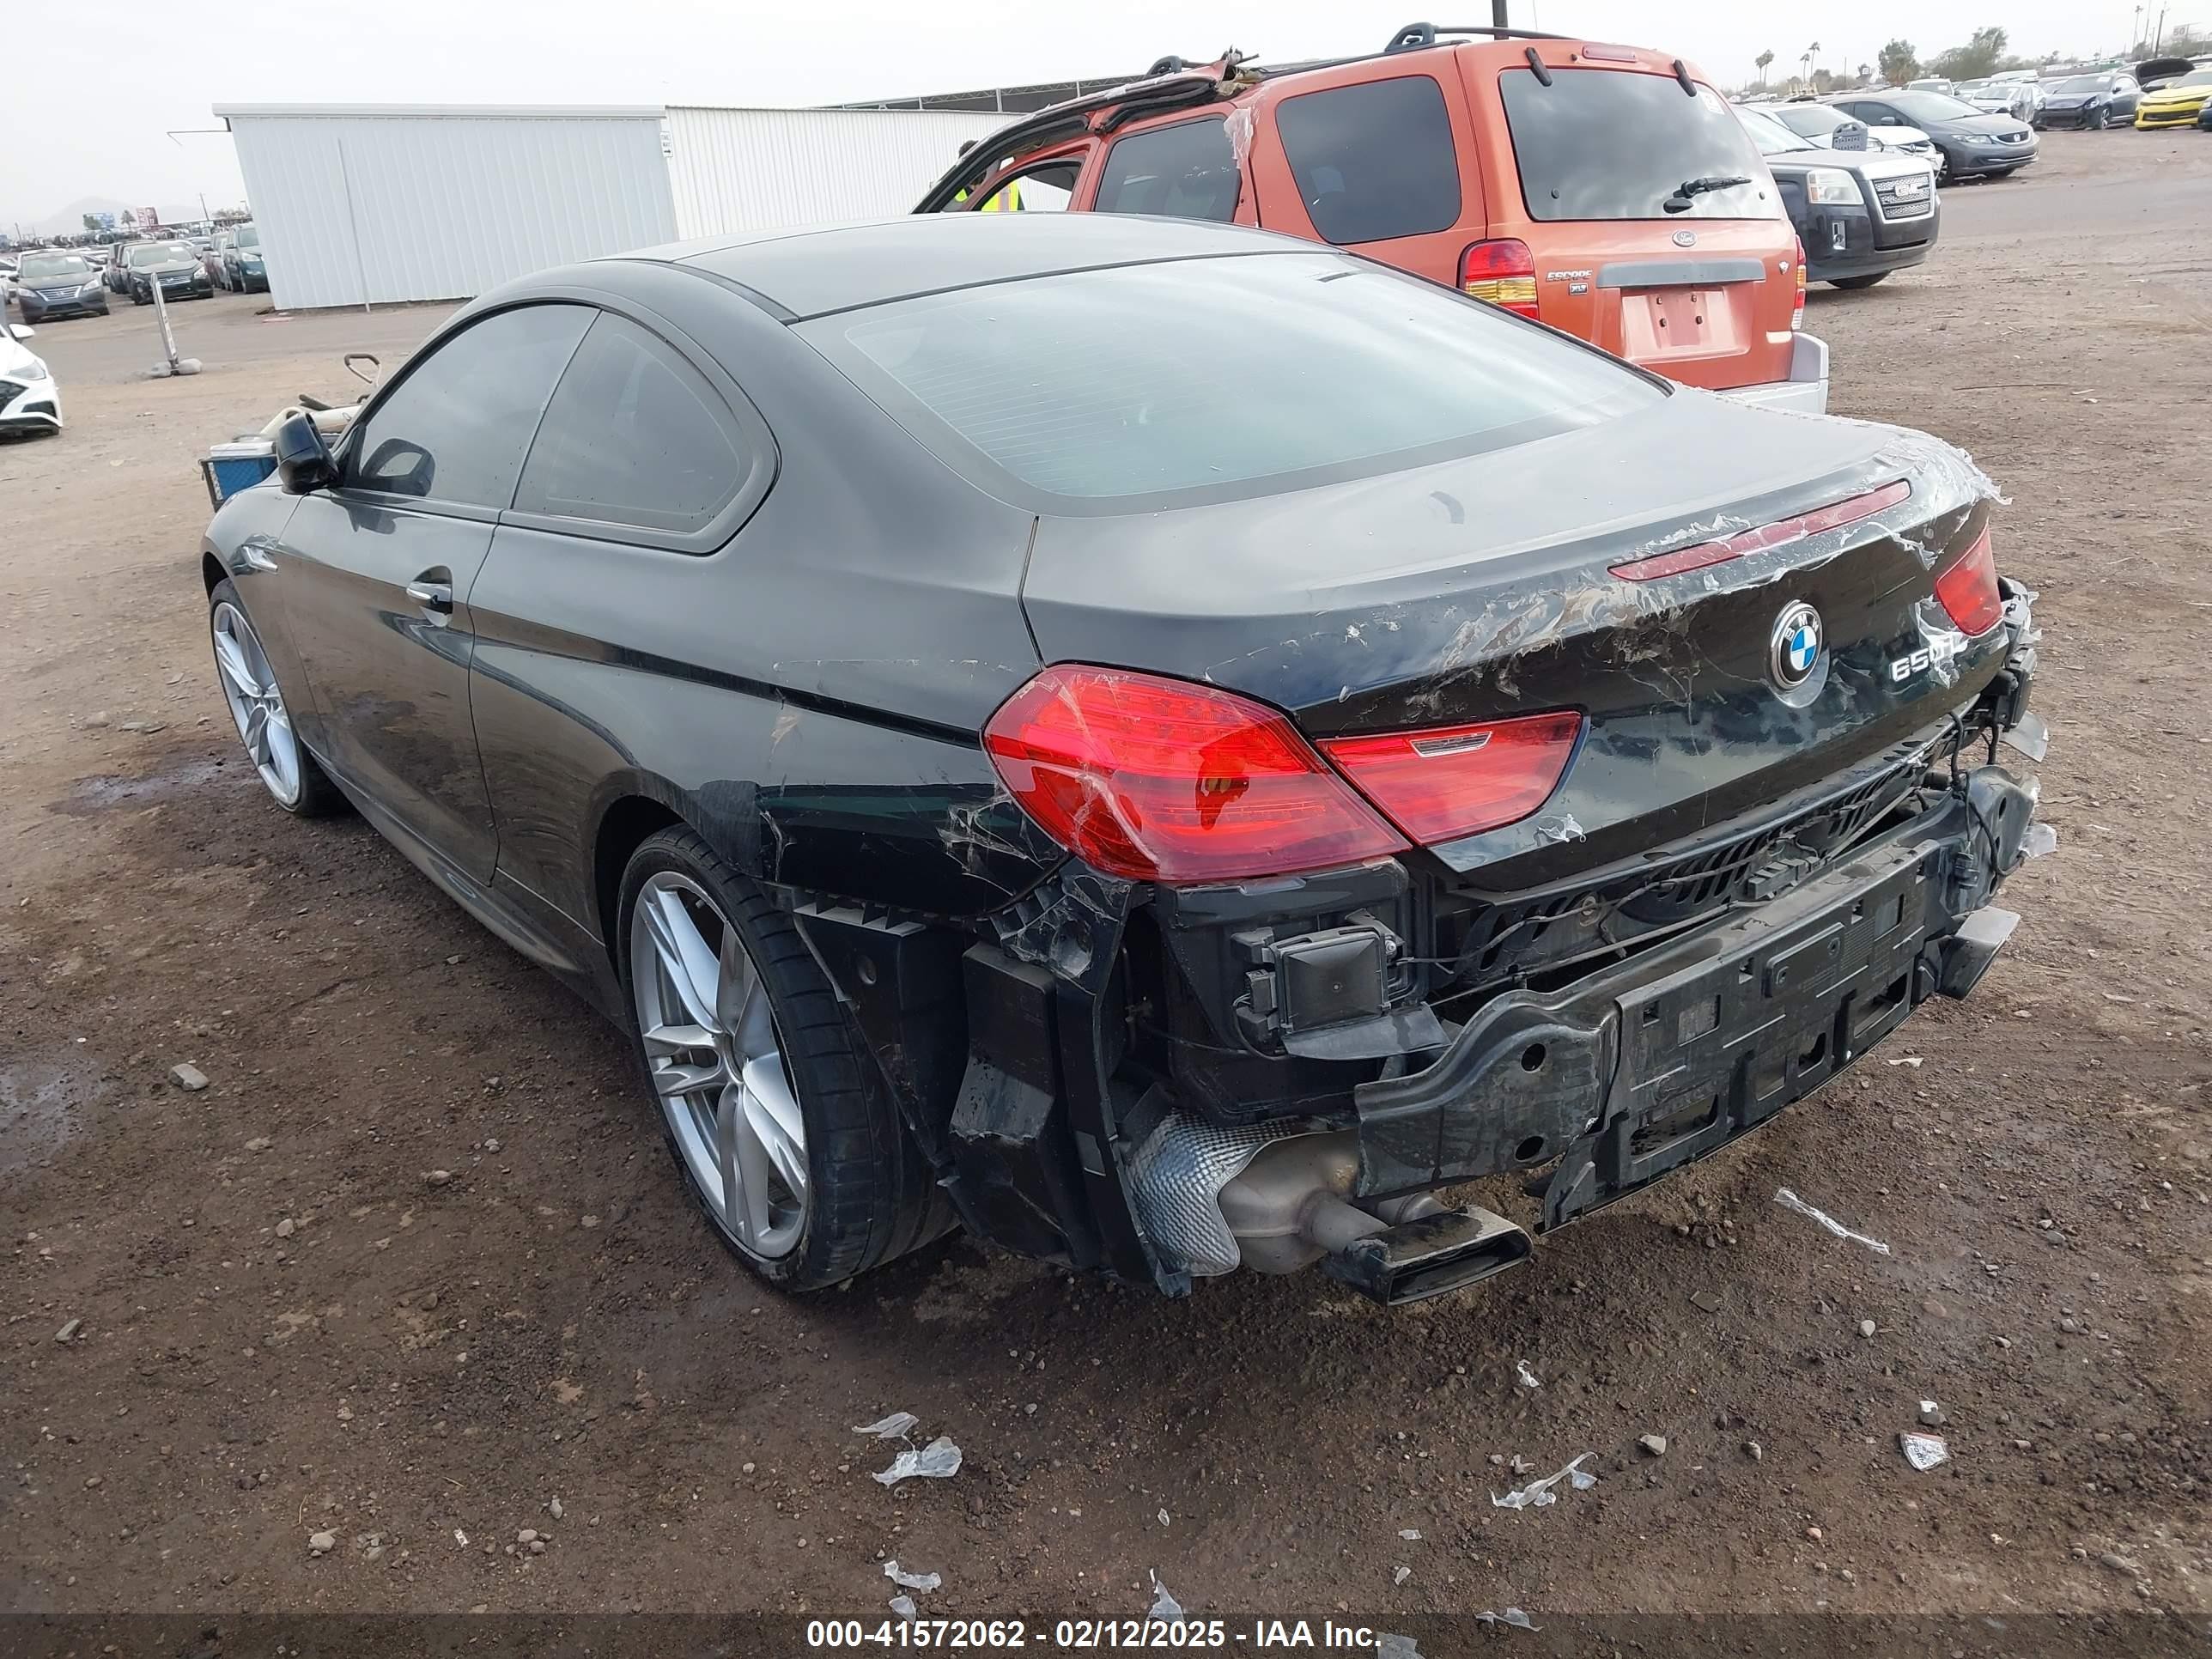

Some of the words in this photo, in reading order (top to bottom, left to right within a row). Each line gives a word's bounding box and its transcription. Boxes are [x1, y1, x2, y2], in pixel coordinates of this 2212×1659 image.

[1894, 181, 1923, 197] GMC
[1547, 270, 1592, 282] ESCAPE
[1785, 613, 1820, 642] BMW
